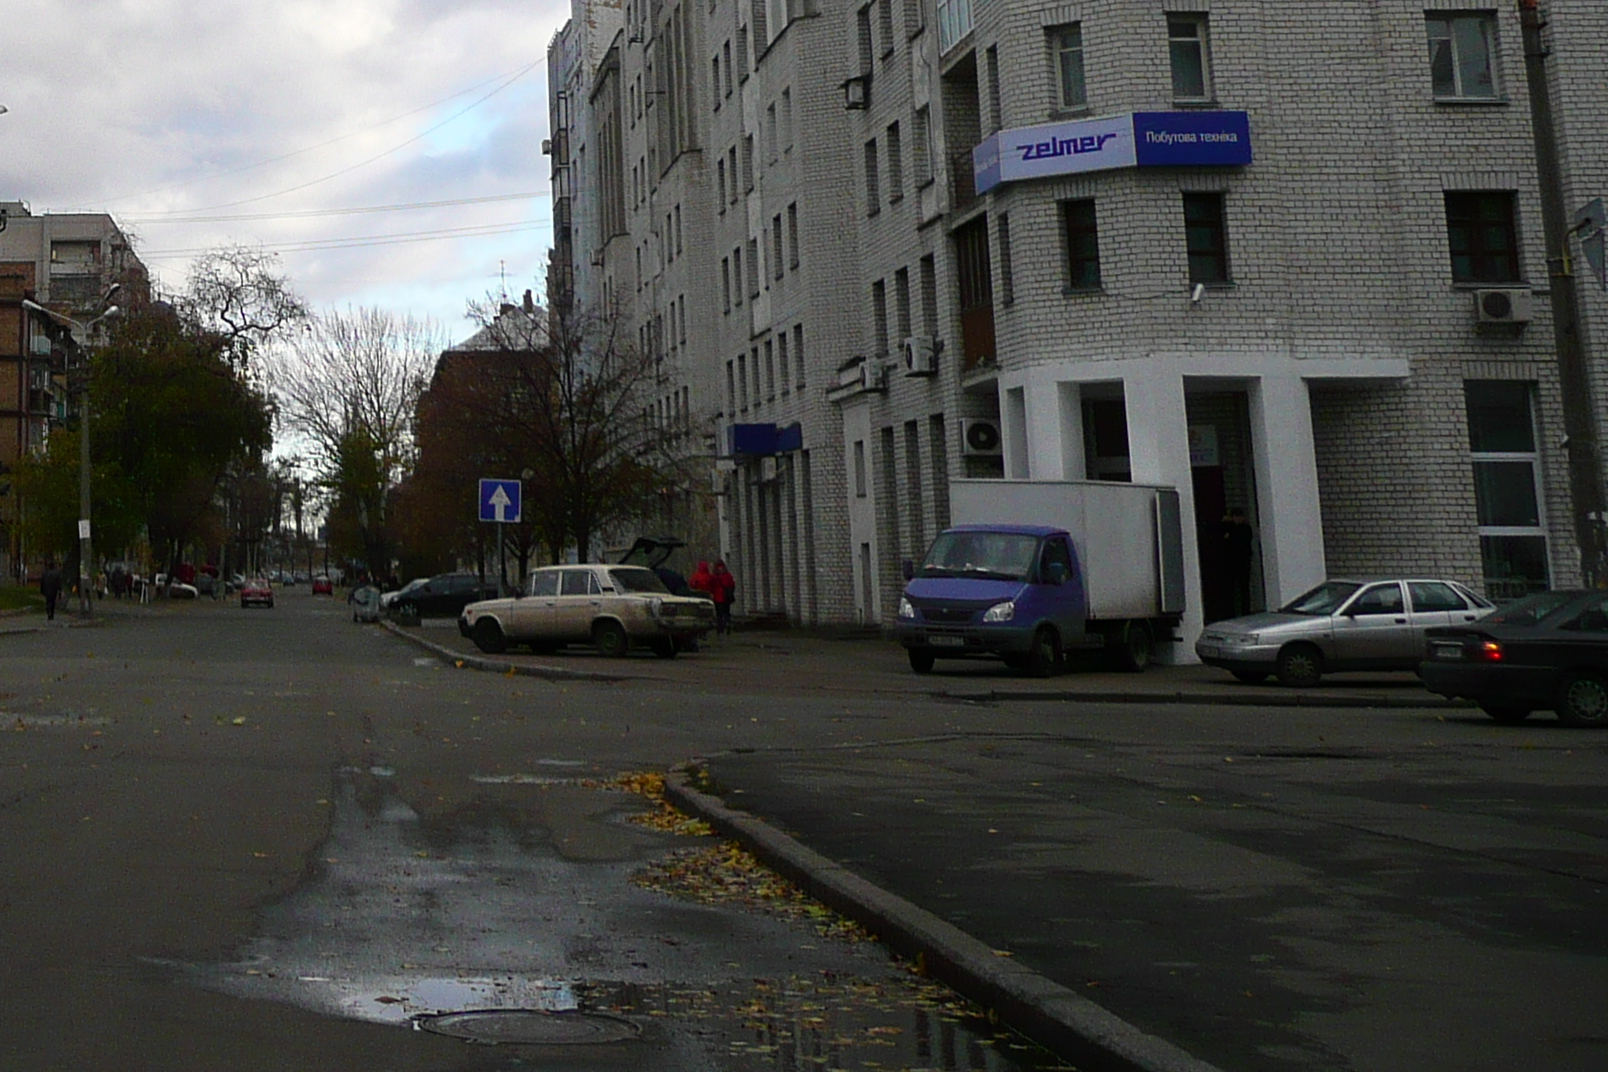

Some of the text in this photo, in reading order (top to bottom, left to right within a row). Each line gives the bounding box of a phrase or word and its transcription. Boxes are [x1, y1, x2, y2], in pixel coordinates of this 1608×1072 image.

[1016, 133, 1117, 161] zelmer
[1146, 130, 1238, 146] Побутова техніка
